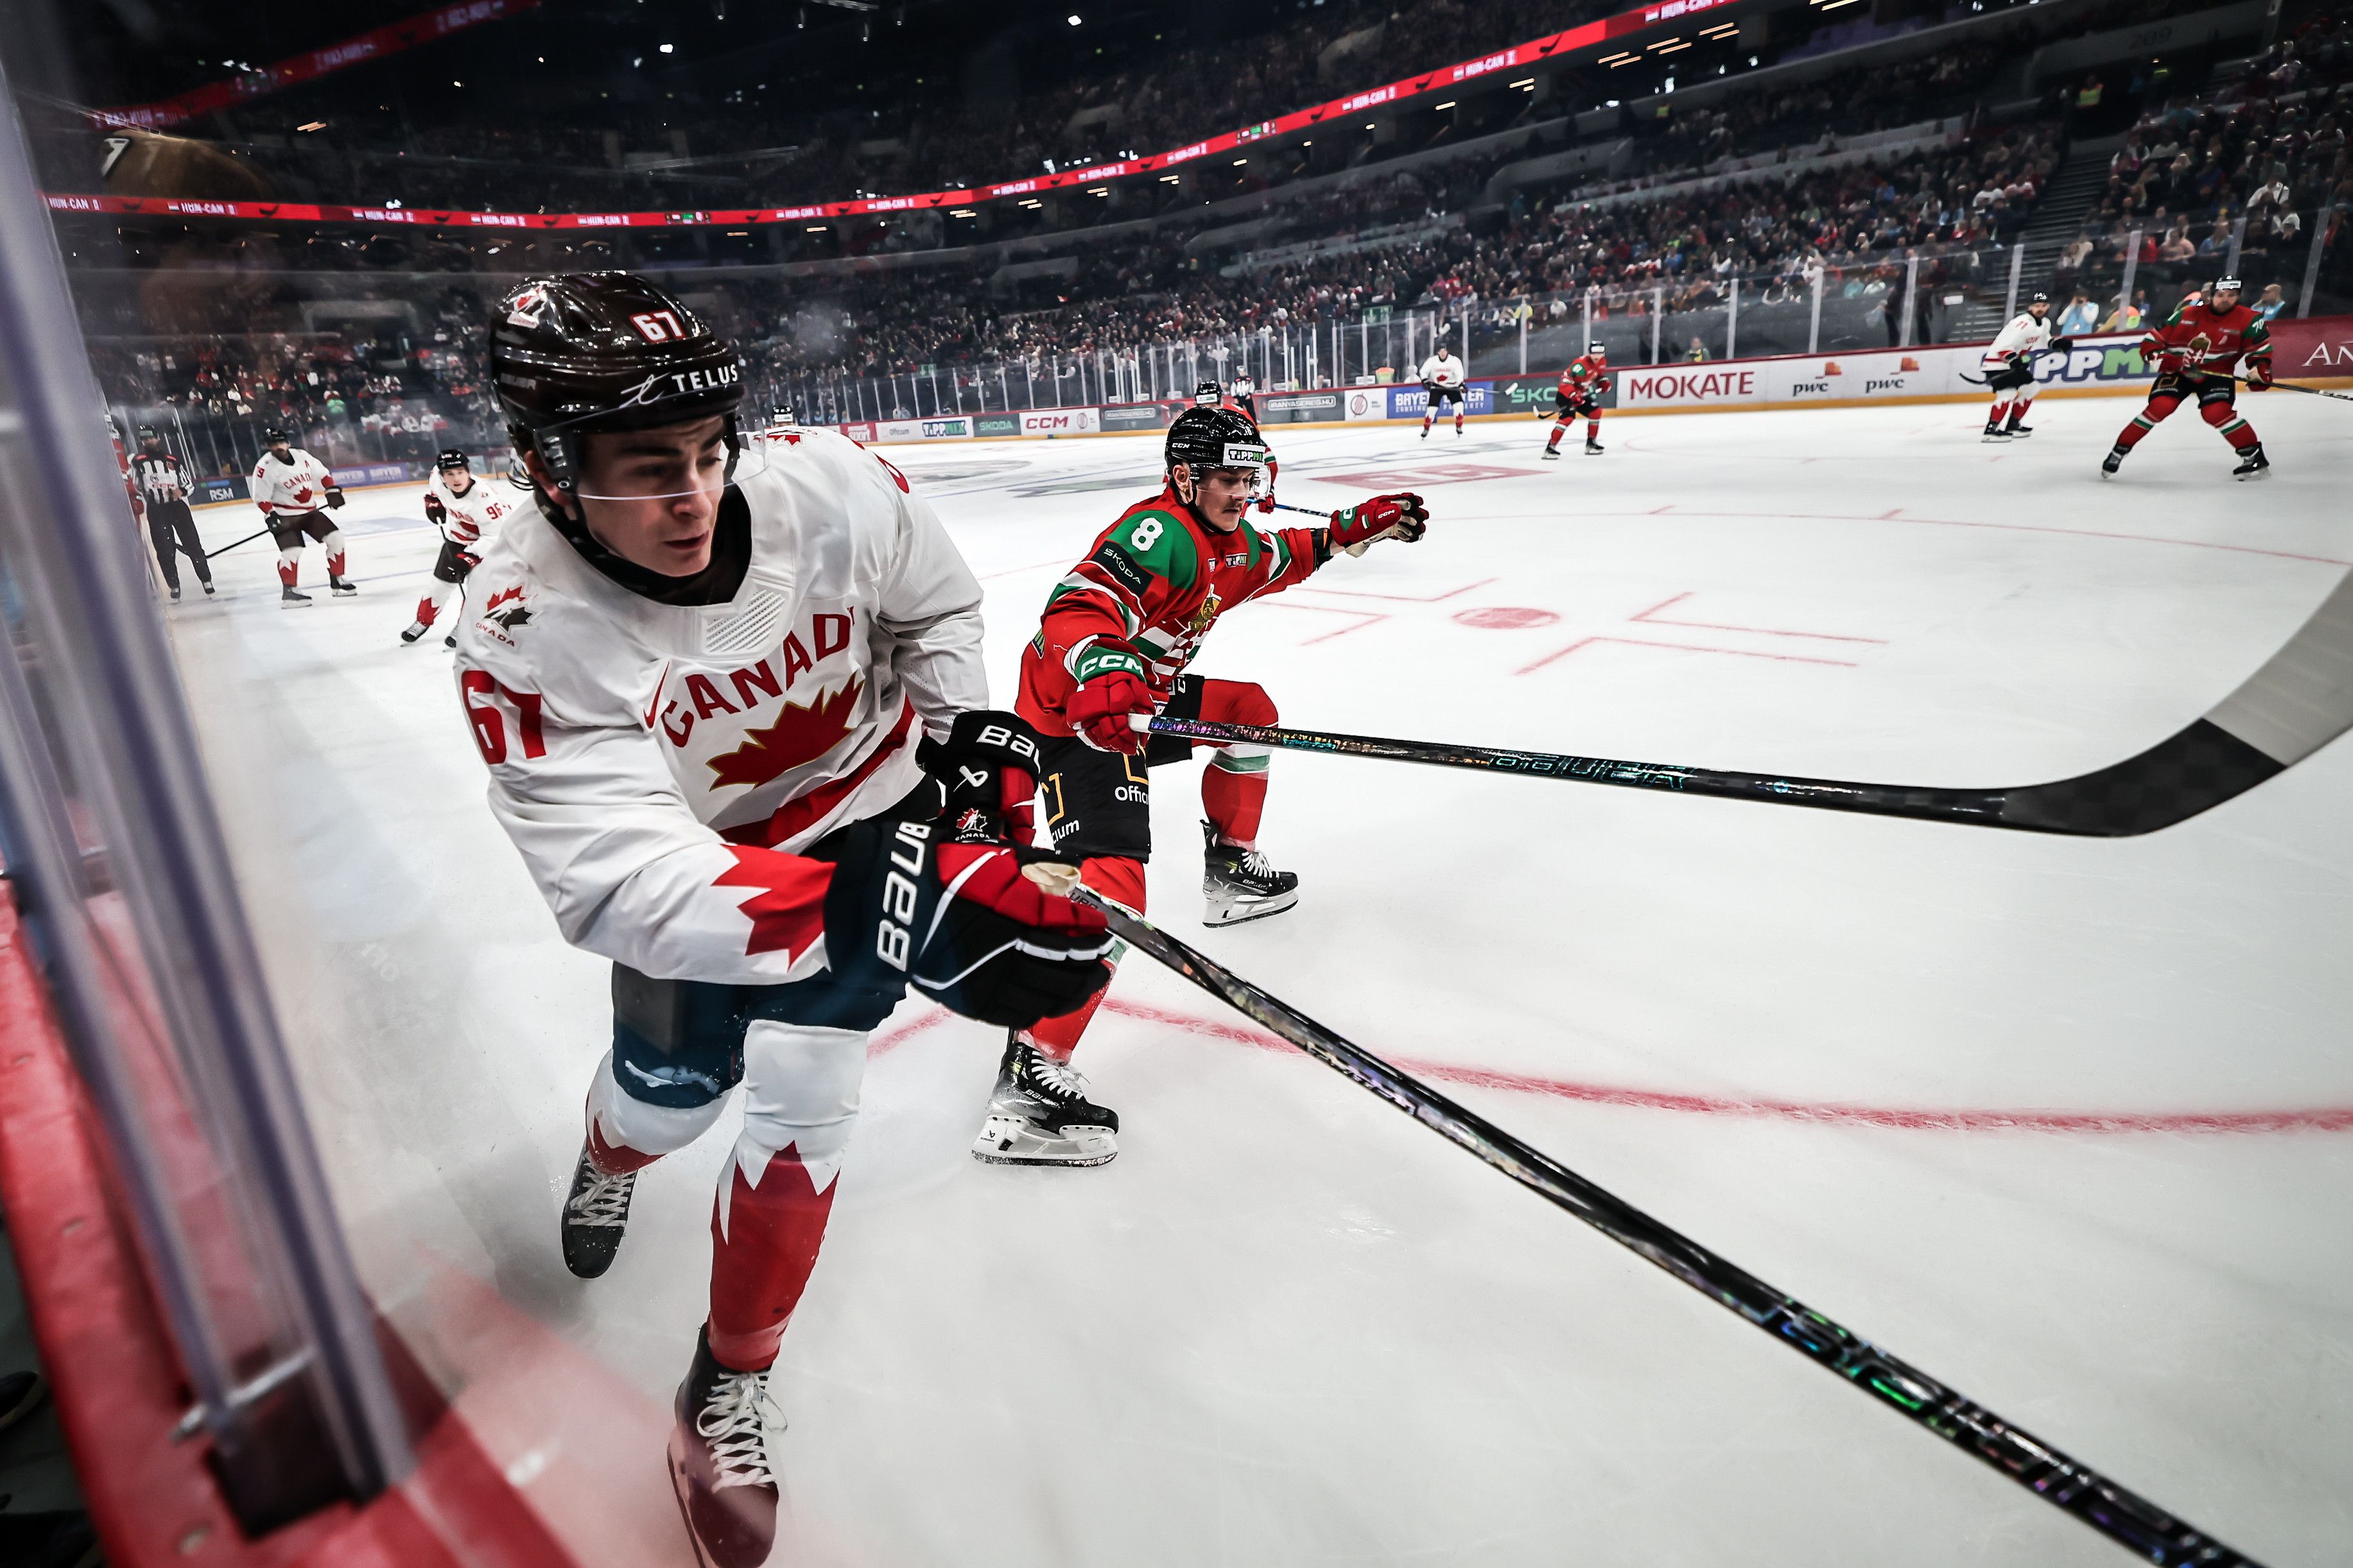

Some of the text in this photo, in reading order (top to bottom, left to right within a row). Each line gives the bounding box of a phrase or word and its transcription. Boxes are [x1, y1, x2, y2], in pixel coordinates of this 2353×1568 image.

[630, 309, 686, 344] 67
[672, 364, 738, 392] TELUS
[1630, 371, 1755, 401] MOKATE
[1865, 377, 1905, 393] pwc
[1793, 381, 1830, 397] pwc
[1395, 392, 1430, 406] BAYE
[1026, 416, 1069, 429] CCM
[283, 472, 312, 490] CANAD
[209, 487, 234, 501] RSM
[485, 503, 503, 520] 96
[1378, 509, 1396, 519] CCM
[1131, 517, 1164, 551] 8
[476, 622, 515, 648] CANADA
[1081, 654, 1145, 677] CCM
[462, 669, 546, 764] 67
[955, 832, 990, 841] CANADA
